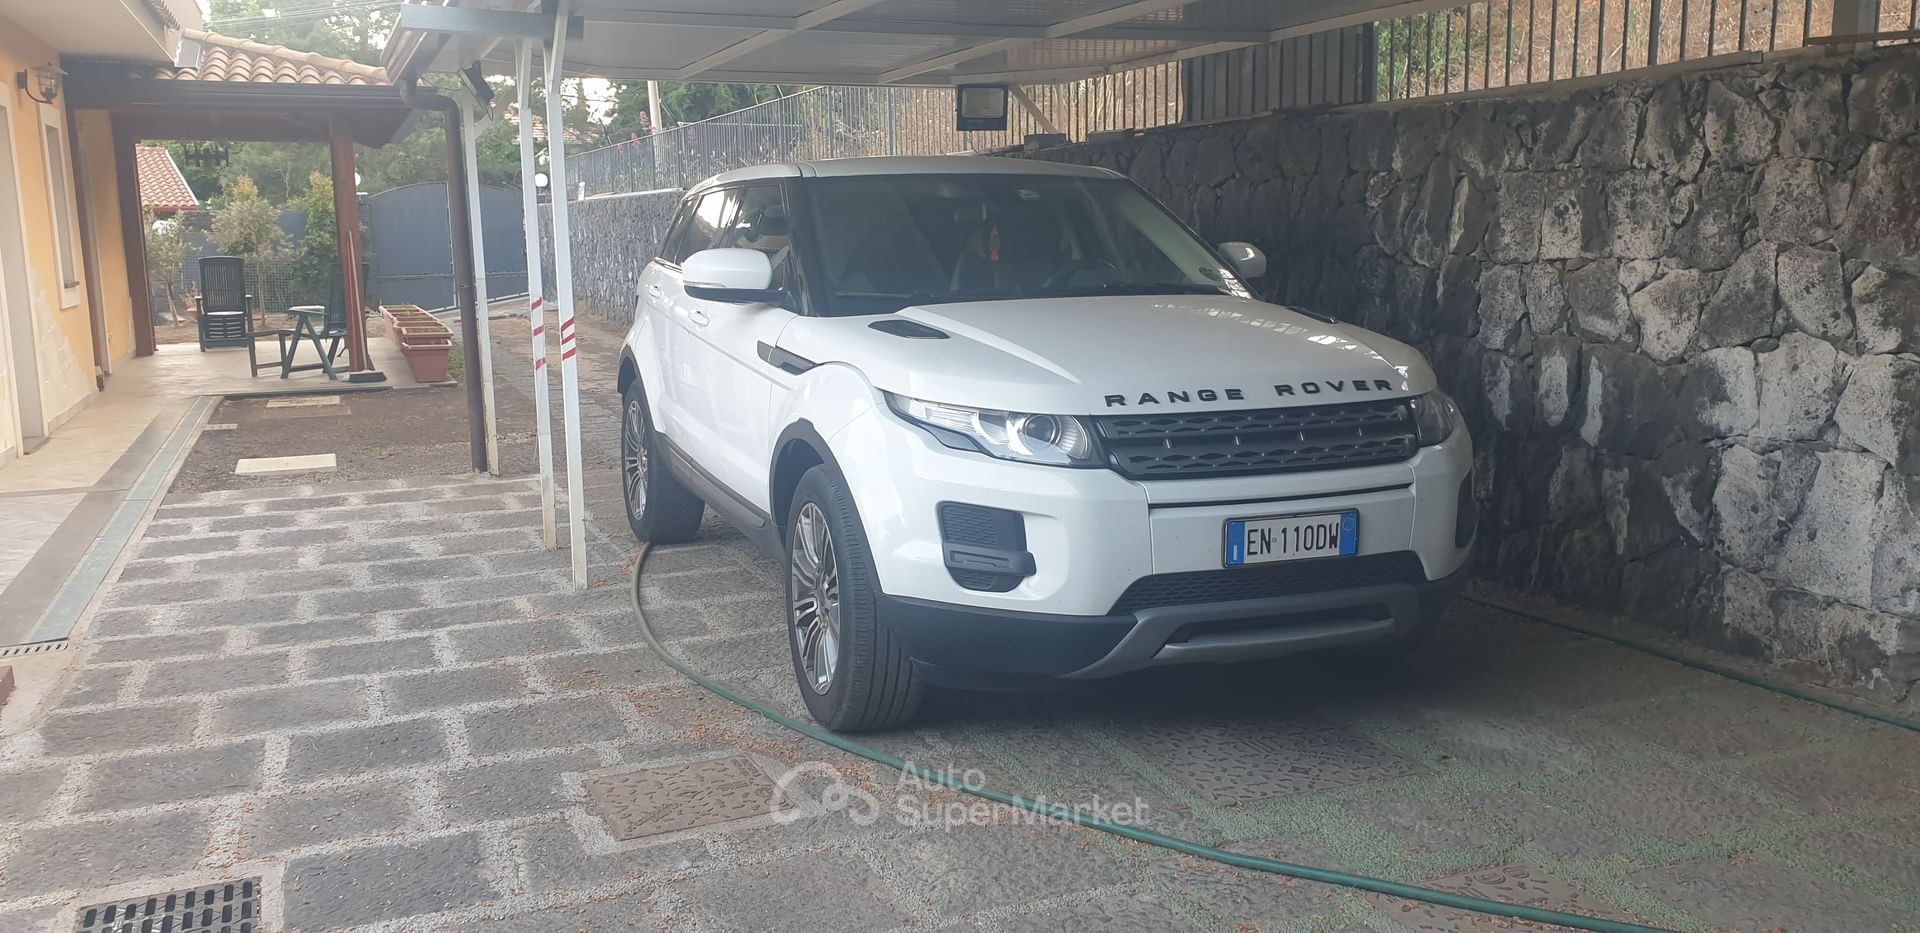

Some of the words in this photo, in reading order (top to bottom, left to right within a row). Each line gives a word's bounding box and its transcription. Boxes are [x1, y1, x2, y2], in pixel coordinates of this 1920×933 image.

[1104, 388, 1245, 407] RANGE
[1274, 379, 1393, 397] ROVER
[1247, 527, 1272, 556] EN
[1281, 522, 1339, 553] 110DW
